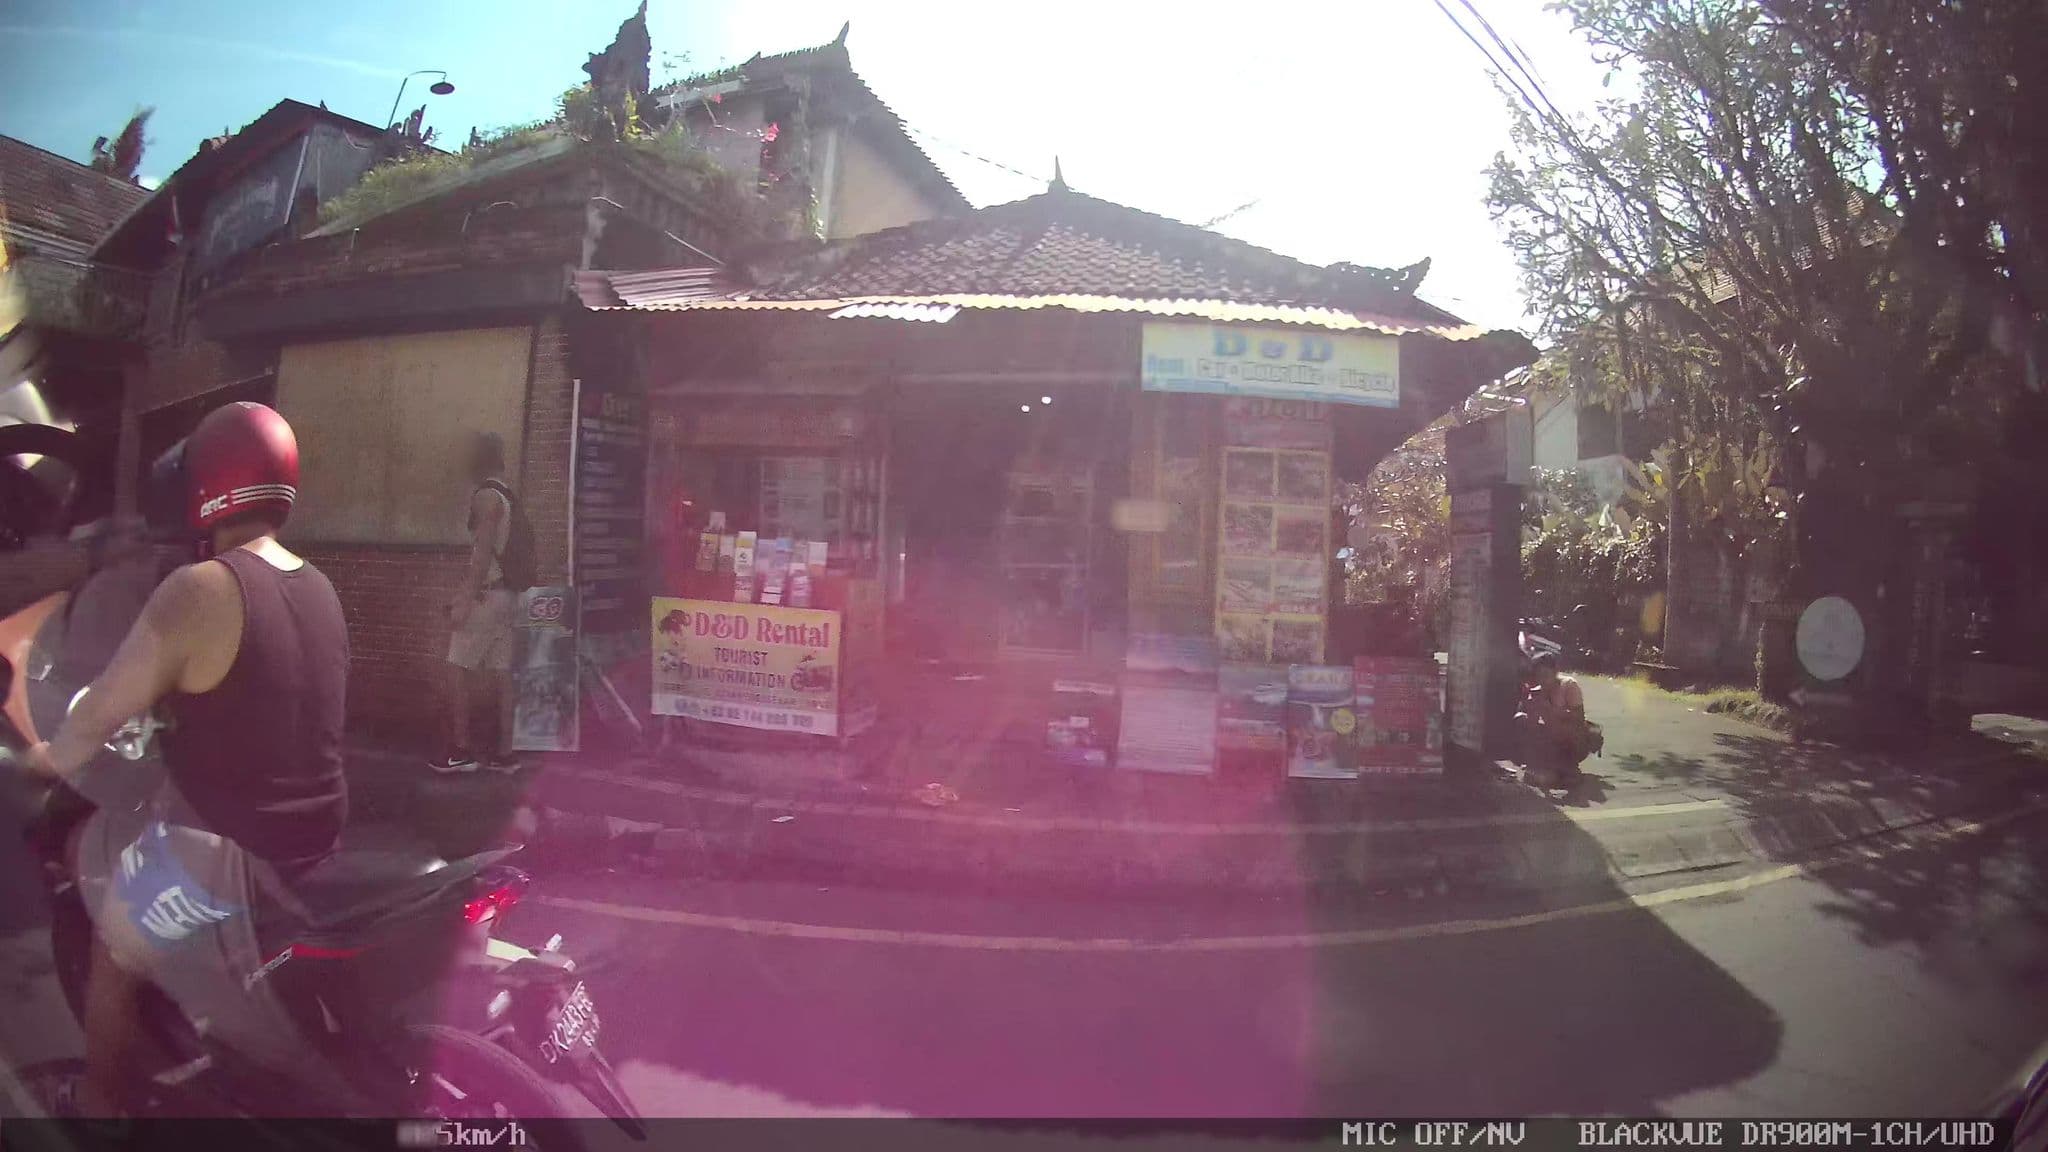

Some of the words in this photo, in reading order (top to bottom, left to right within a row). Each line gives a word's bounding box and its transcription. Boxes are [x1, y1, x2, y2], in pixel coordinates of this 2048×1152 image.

[694, 611, 750, 642] D&D
[756, 616, 831, 649] Rental
[713, 646, 769, 667] TOURIST
[696, 666, 787, 689] INFORMATION
